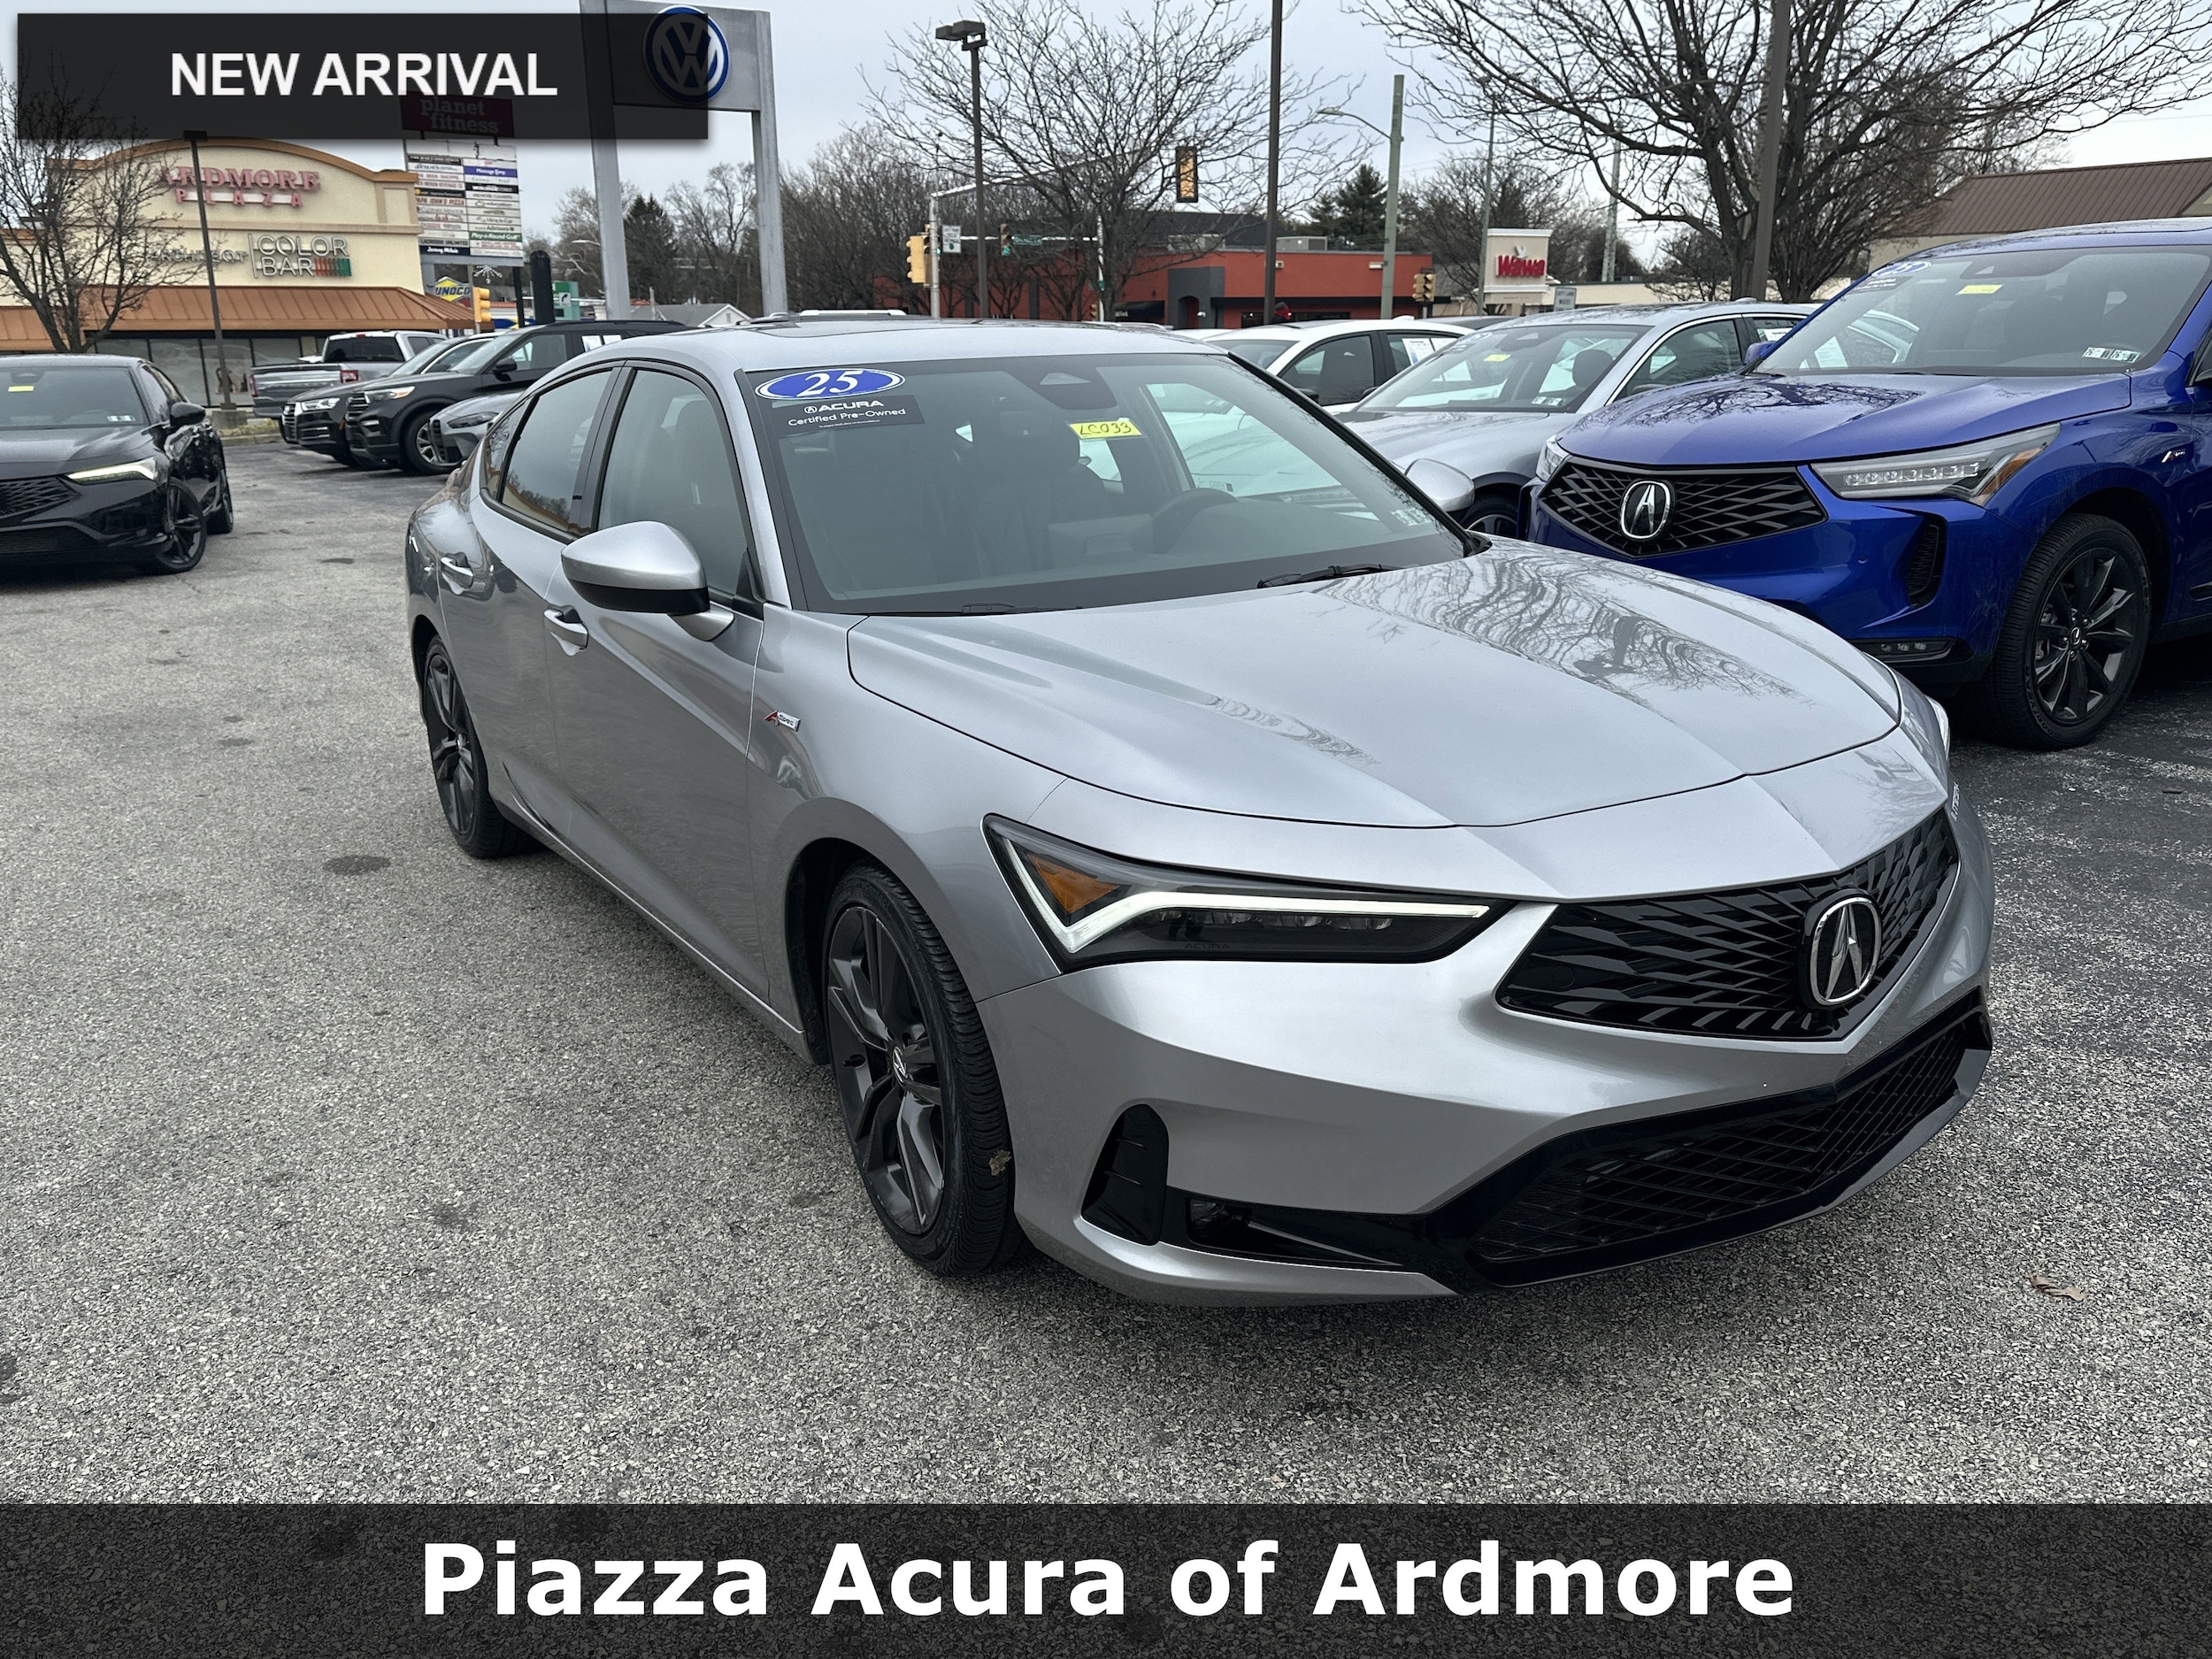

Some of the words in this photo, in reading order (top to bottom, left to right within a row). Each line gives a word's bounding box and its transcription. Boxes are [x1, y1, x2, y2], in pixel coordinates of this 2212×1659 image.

[419, 96, 486, 116] planet
[430, 113, 499, 134] fitness
[159, 165, 321, 192] ARDMORE
[176, 188, 303, 207] PLAZA
[257, 234, 349, 257] COLOR
[261, 257, 315, 276] BAR
[1496, 255, 1546, 276] Wawa
[435, 287, 470, 296] UNOCO
[796, 370, 864, 397] 25
[818, 400, 884, 412] ACURA
[788, 413, 837, 426] Certified
[840, 408, 906, 419] Pre-Owned
